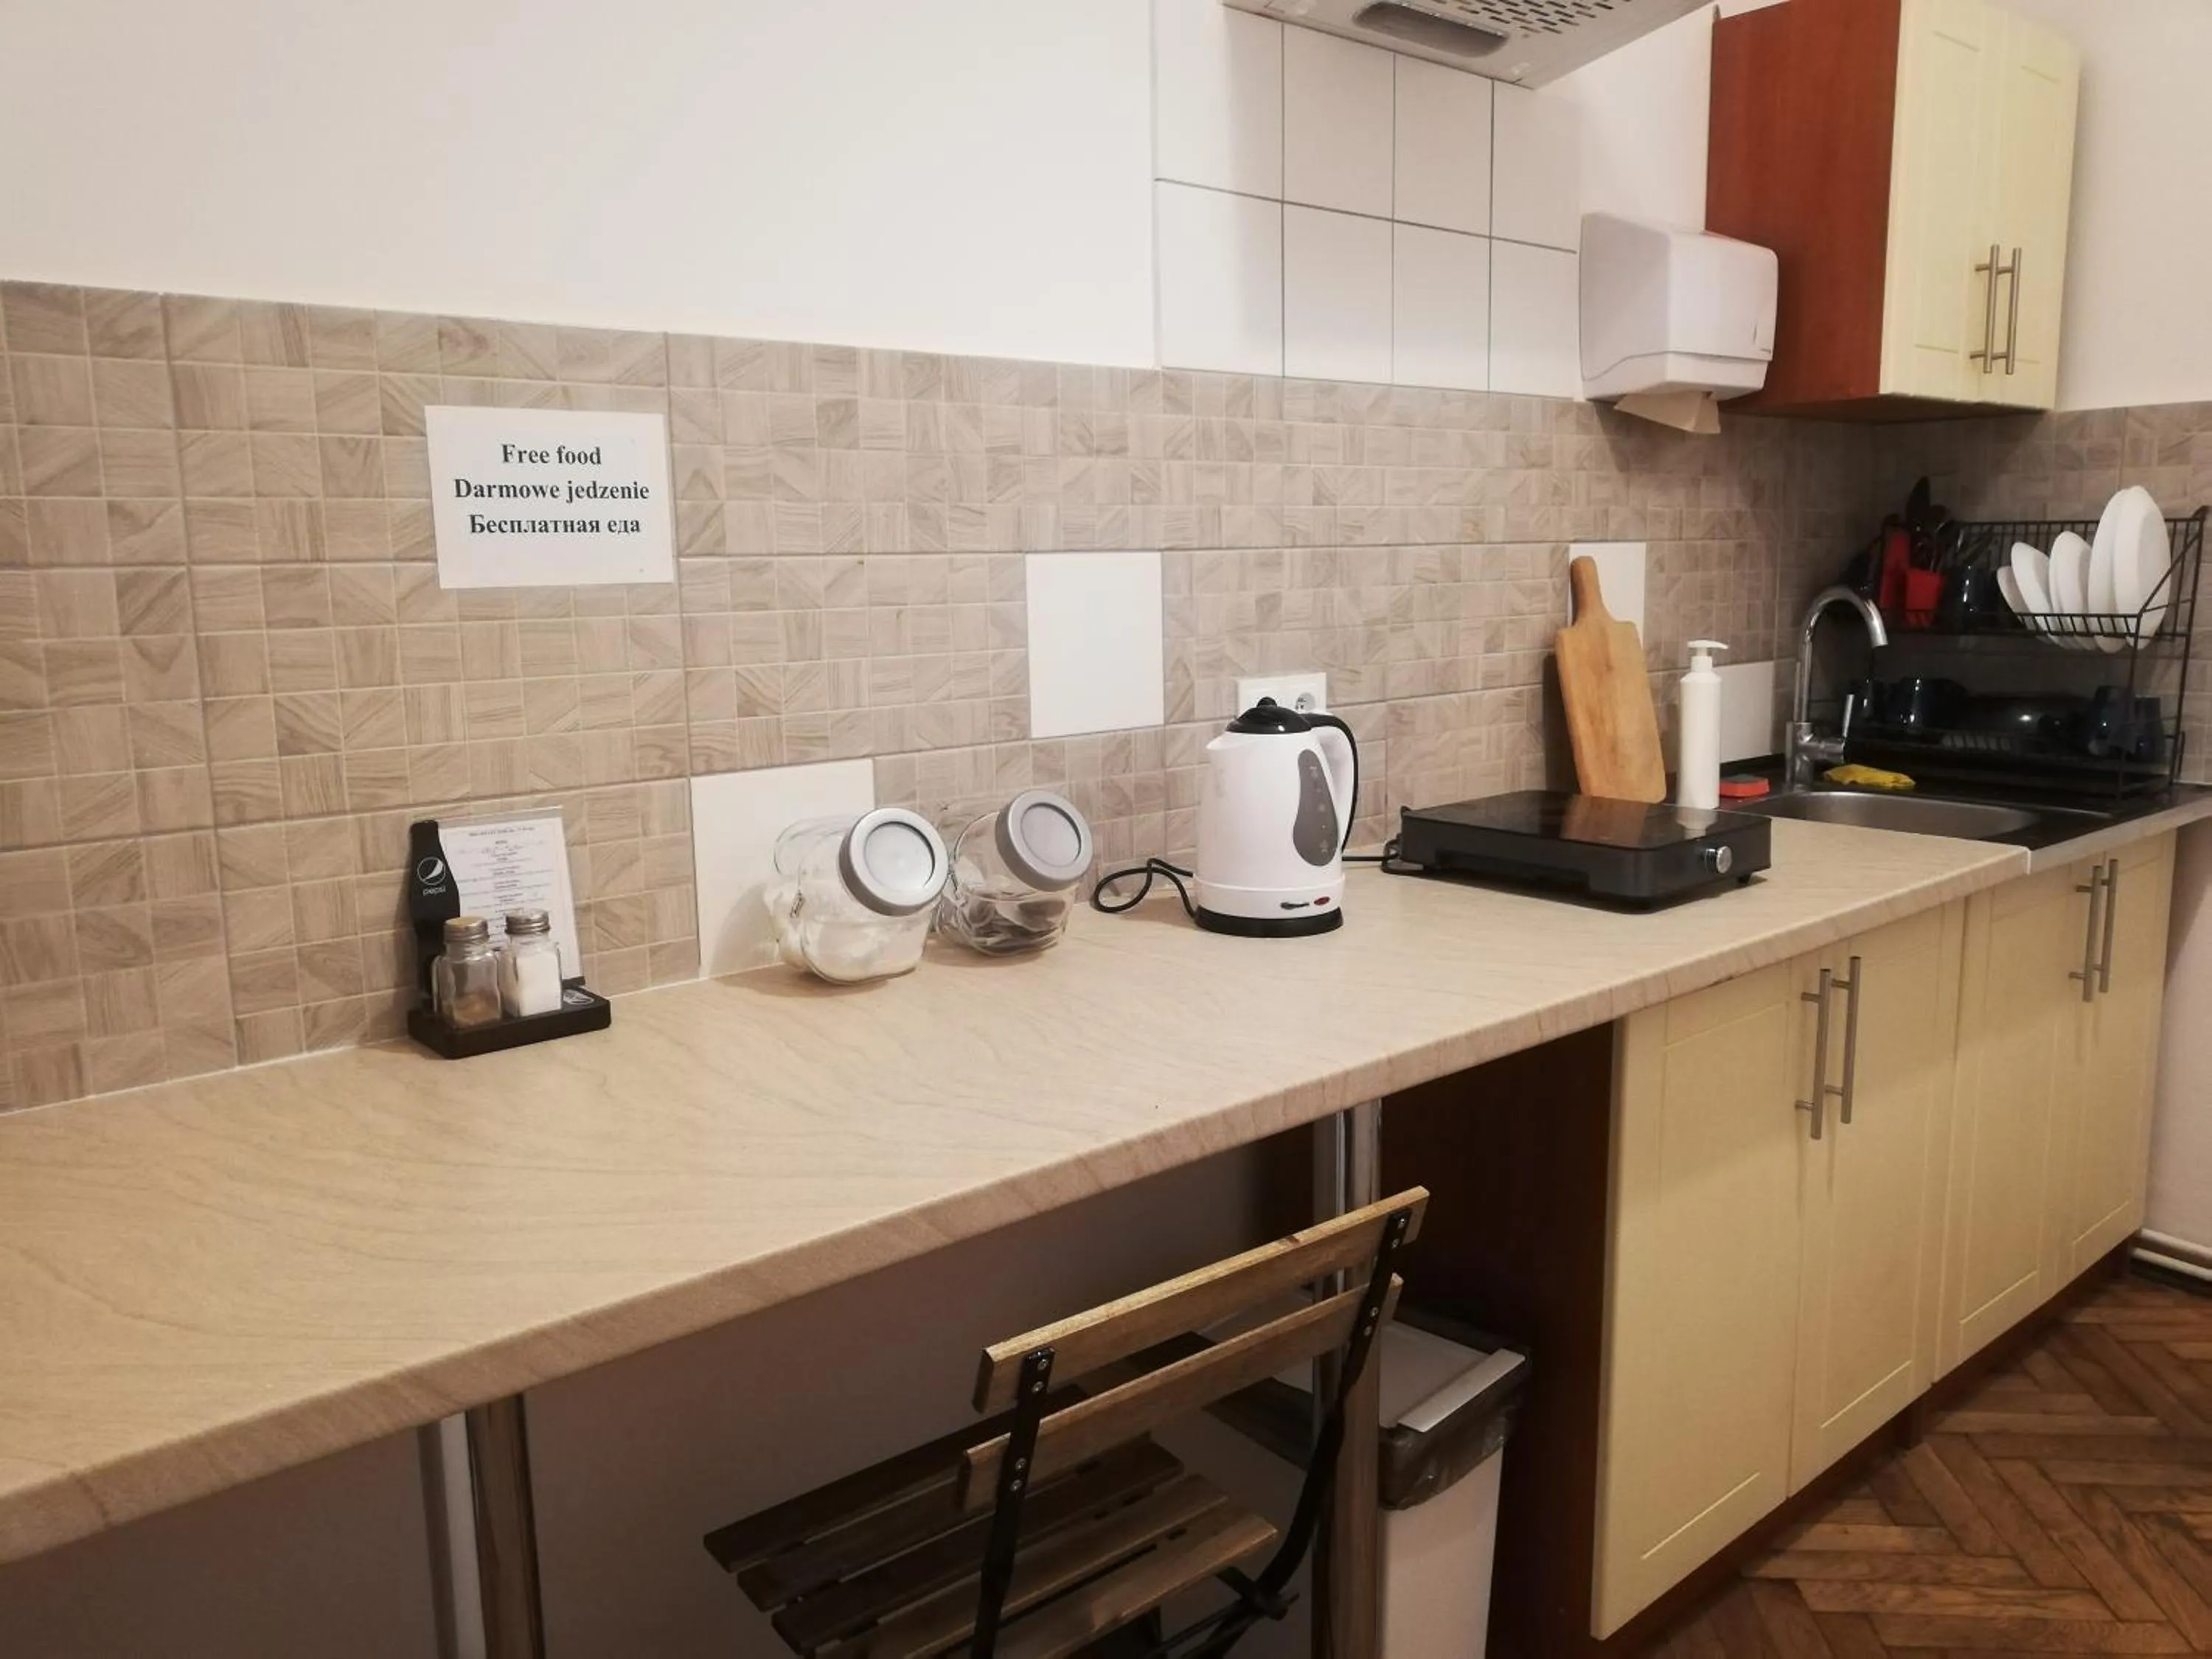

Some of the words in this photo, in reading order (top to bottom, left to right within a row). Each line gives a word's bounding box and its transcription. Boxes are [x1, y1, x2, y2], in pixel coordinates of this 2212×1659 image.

[501, 444, 551, 464] Free
[556, 445, 602, 465] food
[454, 479, 560, 499] Darmowe
[566, 480, 650, 503] jedzenie
[470, 514, 601, 535] Бесплатная
[607, 519, 641, 535] еда
